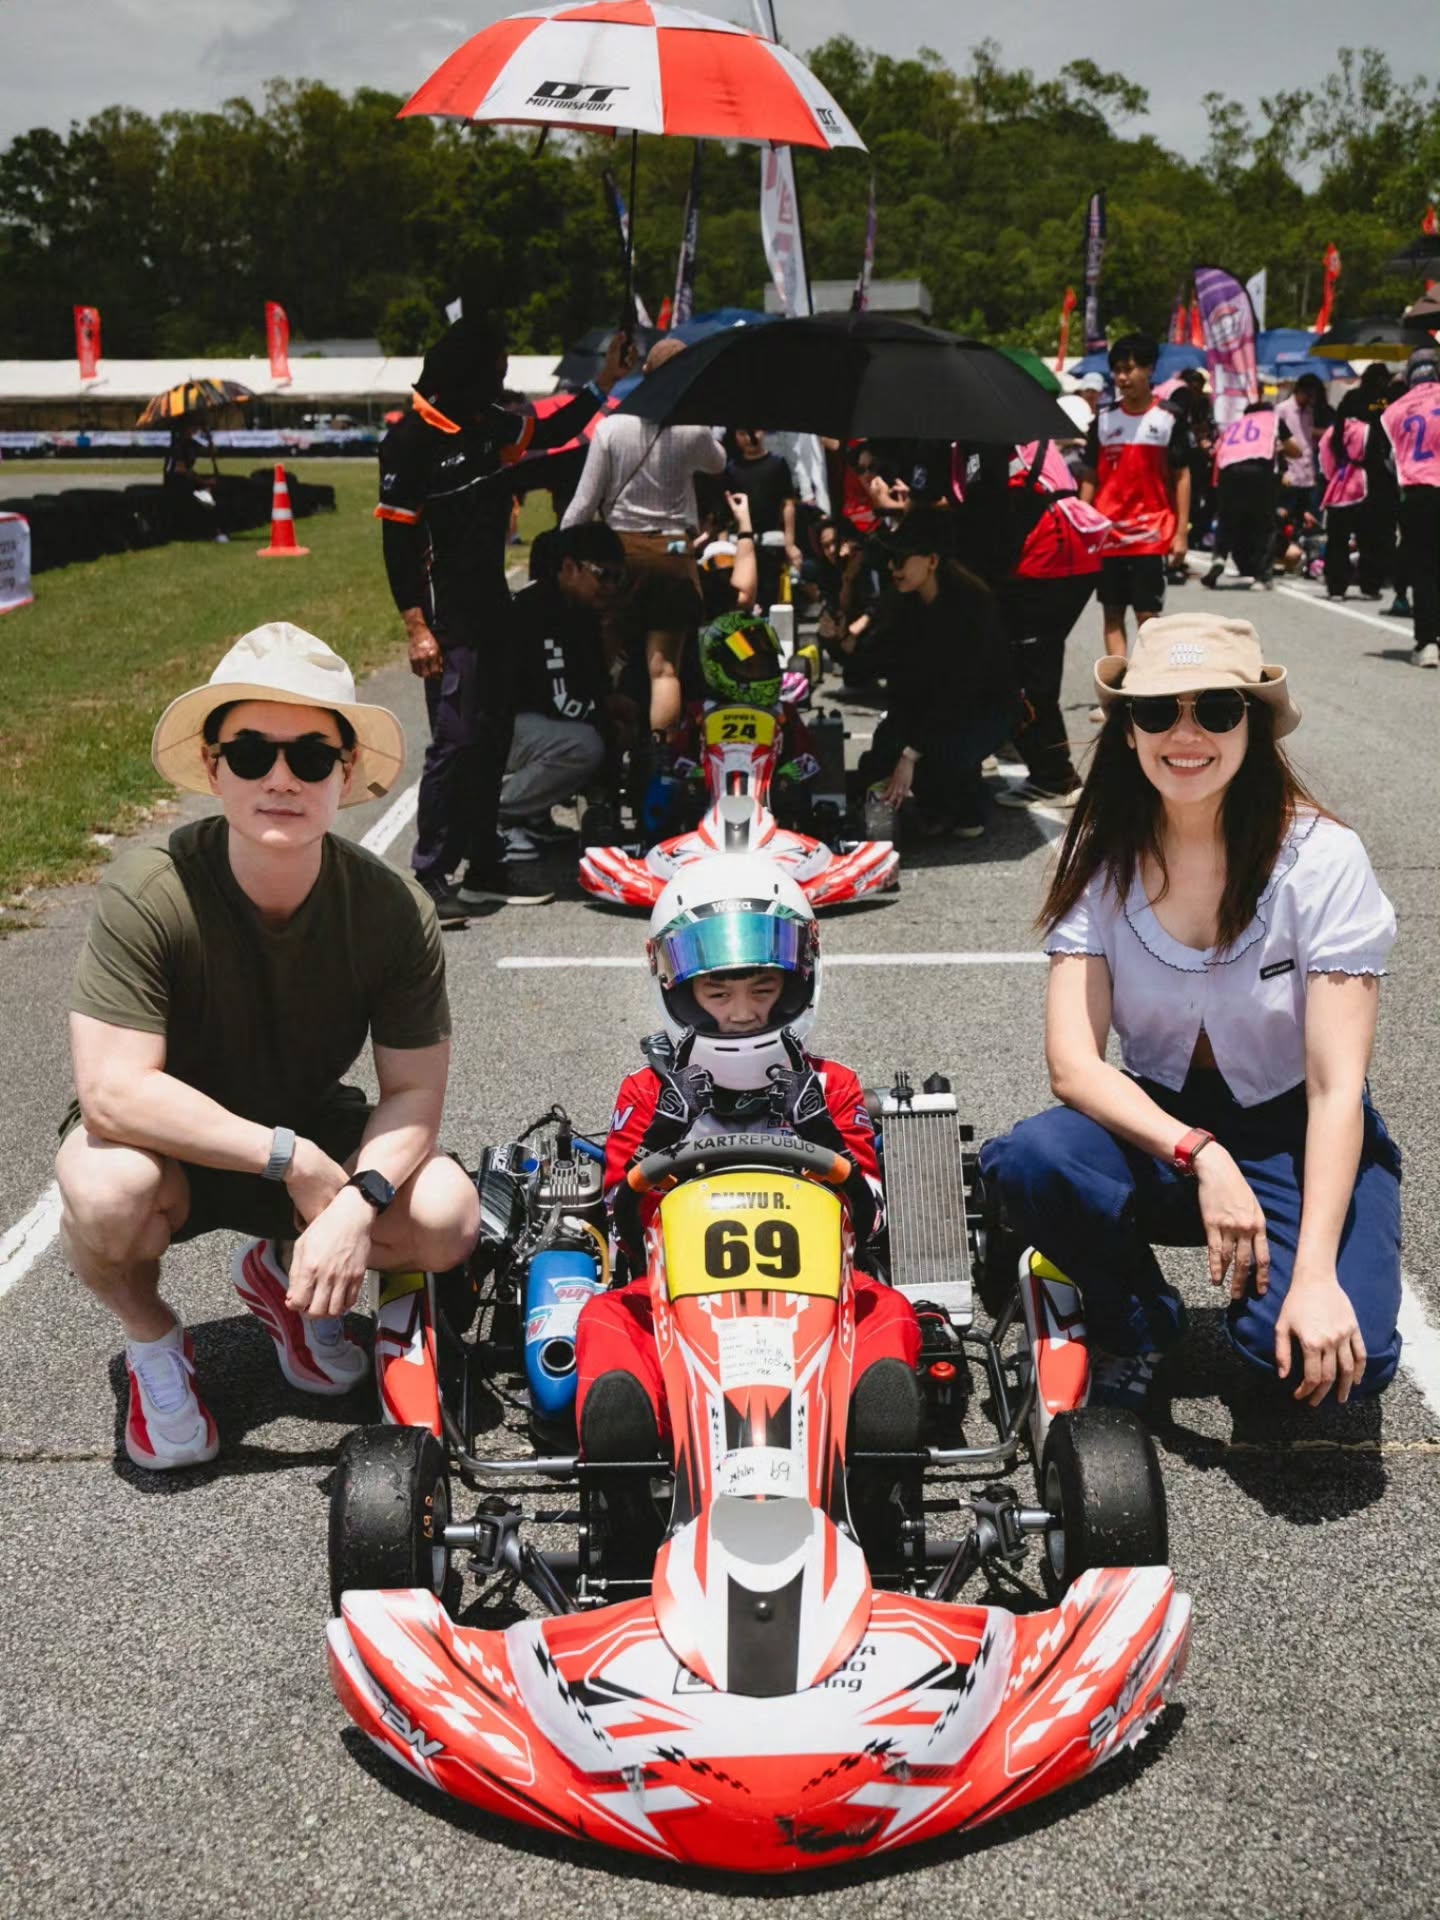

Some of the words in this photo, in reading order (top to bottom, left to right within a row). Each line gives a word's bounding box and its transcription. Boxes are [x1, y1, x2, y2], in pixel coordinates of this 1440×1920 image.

[532, 80, 631, 102] DT
[525, 97, 615, 112] MOTORSPORT
[1227, 420, 1260, 446] 26
[721, 723, 757, 739] 24
[772, 1192, 791, 1209] R.
[704, 1219, 801, 1279] 69
